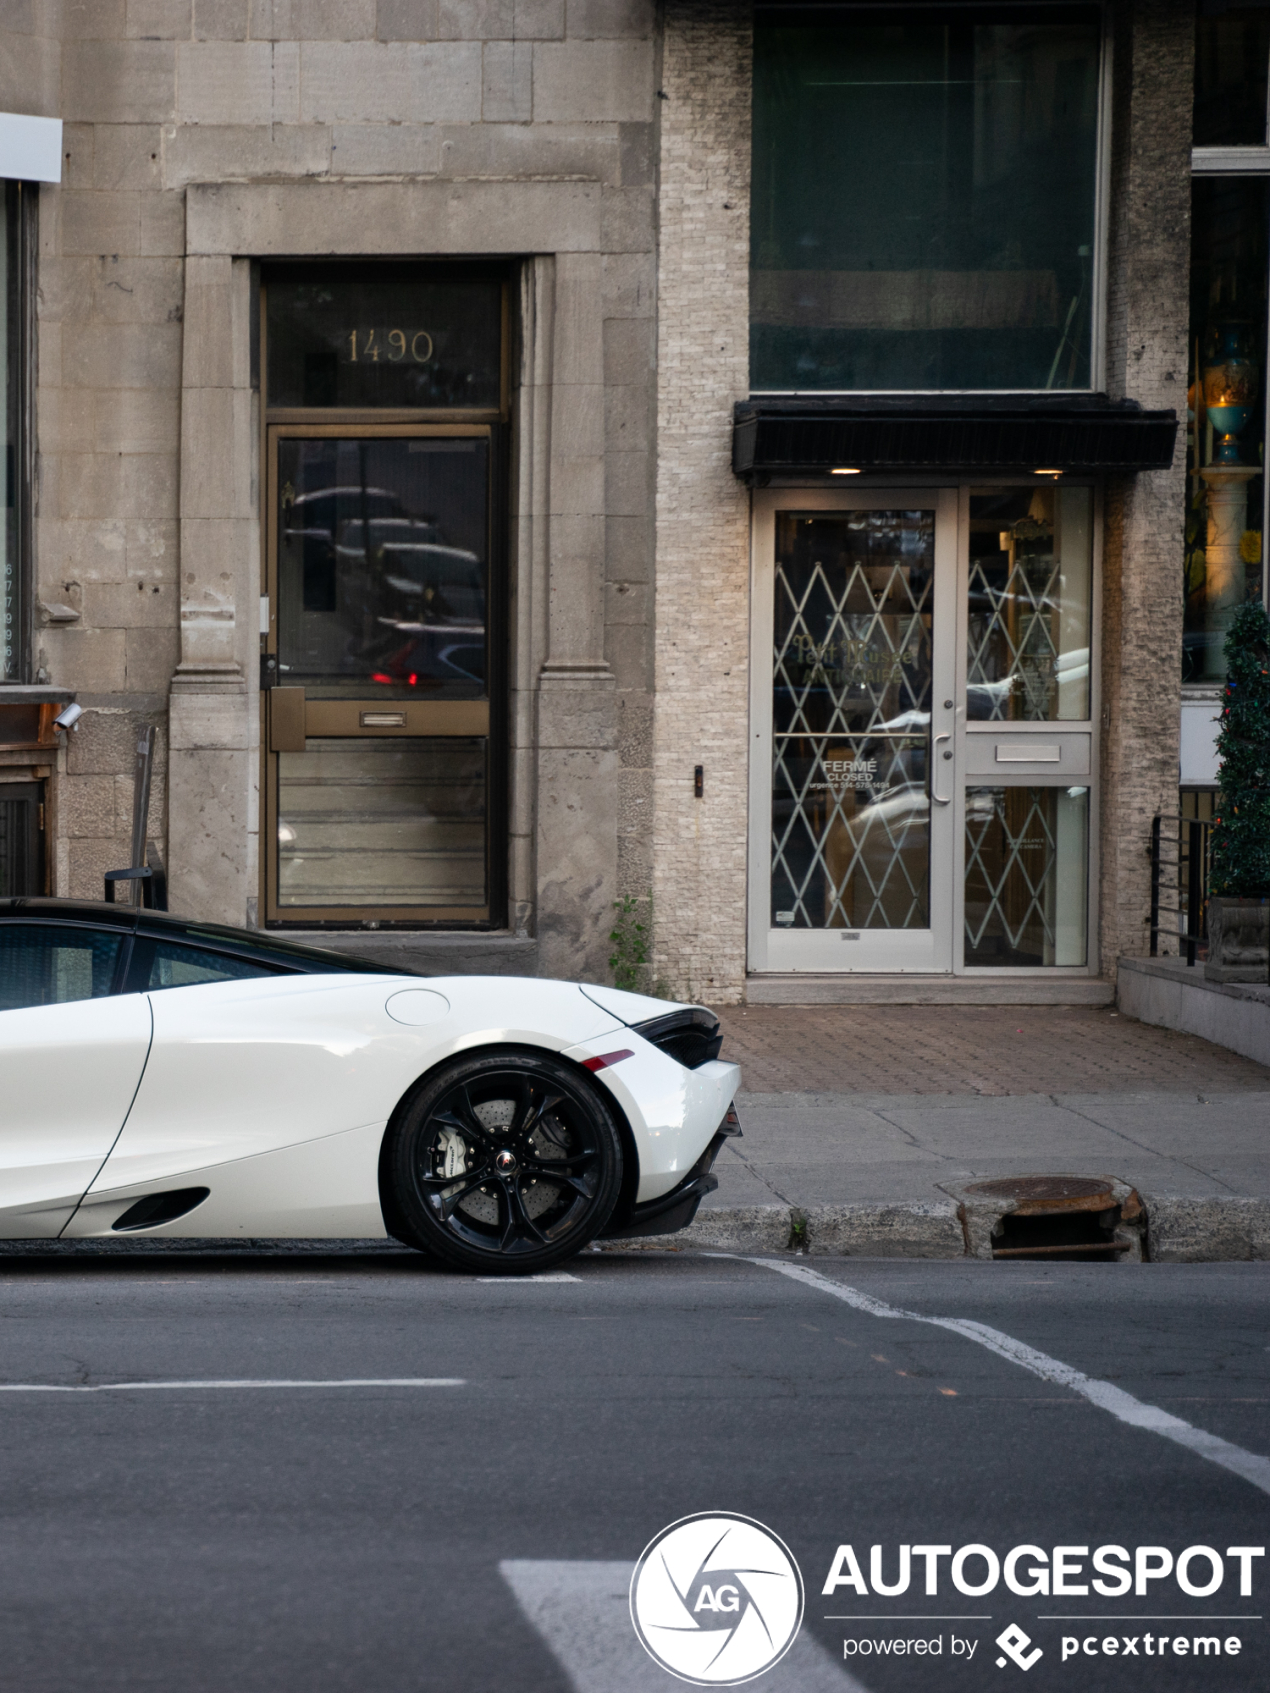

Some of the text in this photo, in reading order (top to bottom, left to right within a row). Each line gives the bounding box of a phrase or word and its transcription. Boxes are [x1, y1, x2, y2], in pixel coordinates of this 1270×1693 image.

[349, 329, 433, 362] 1490
[822, 758, 877, 772] FERMÉ
[827, 773, 874, 782] CLOSED
